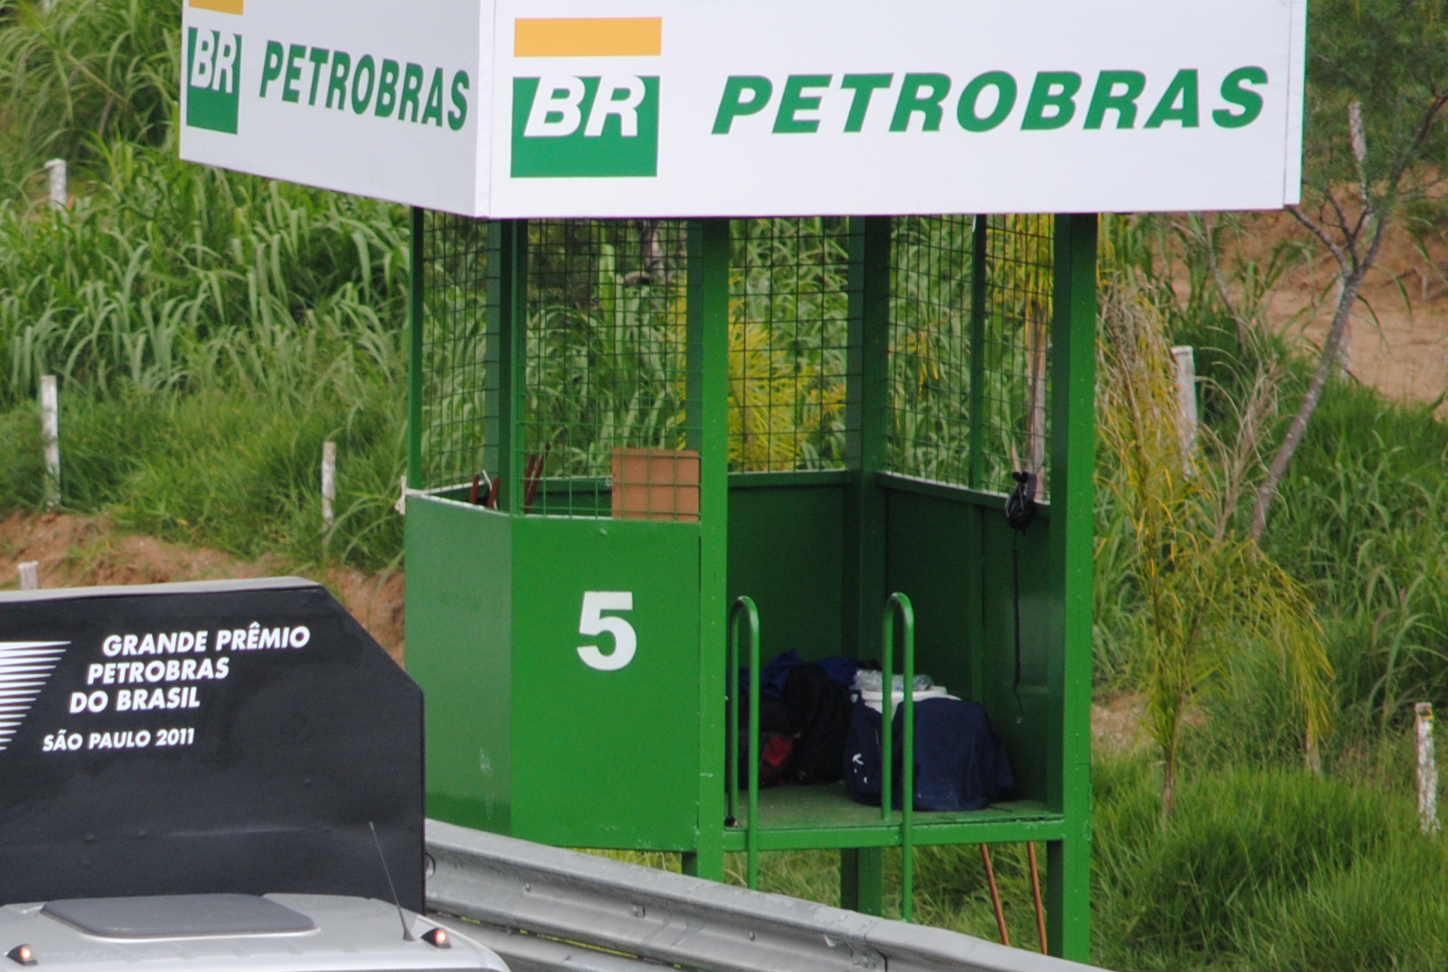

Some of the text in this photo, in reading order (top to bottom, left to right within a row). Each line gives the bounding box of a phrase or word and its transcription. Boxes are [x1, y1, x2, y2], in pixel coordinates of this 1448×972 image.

[190, 27, 470, 131] BR PETROBRAS
[523, 66, 1269, 138] BR PETROBRAS
[102, 621, 311, 658] GRANDE PRÊMIO
[577, 591, 637, 671] 5
[87, 657, 230, 686] PETROBRAS
[69, 686, 201, 714] DO BRASIL
[42, 727, 195, 752] SÃO PAULO 2011
